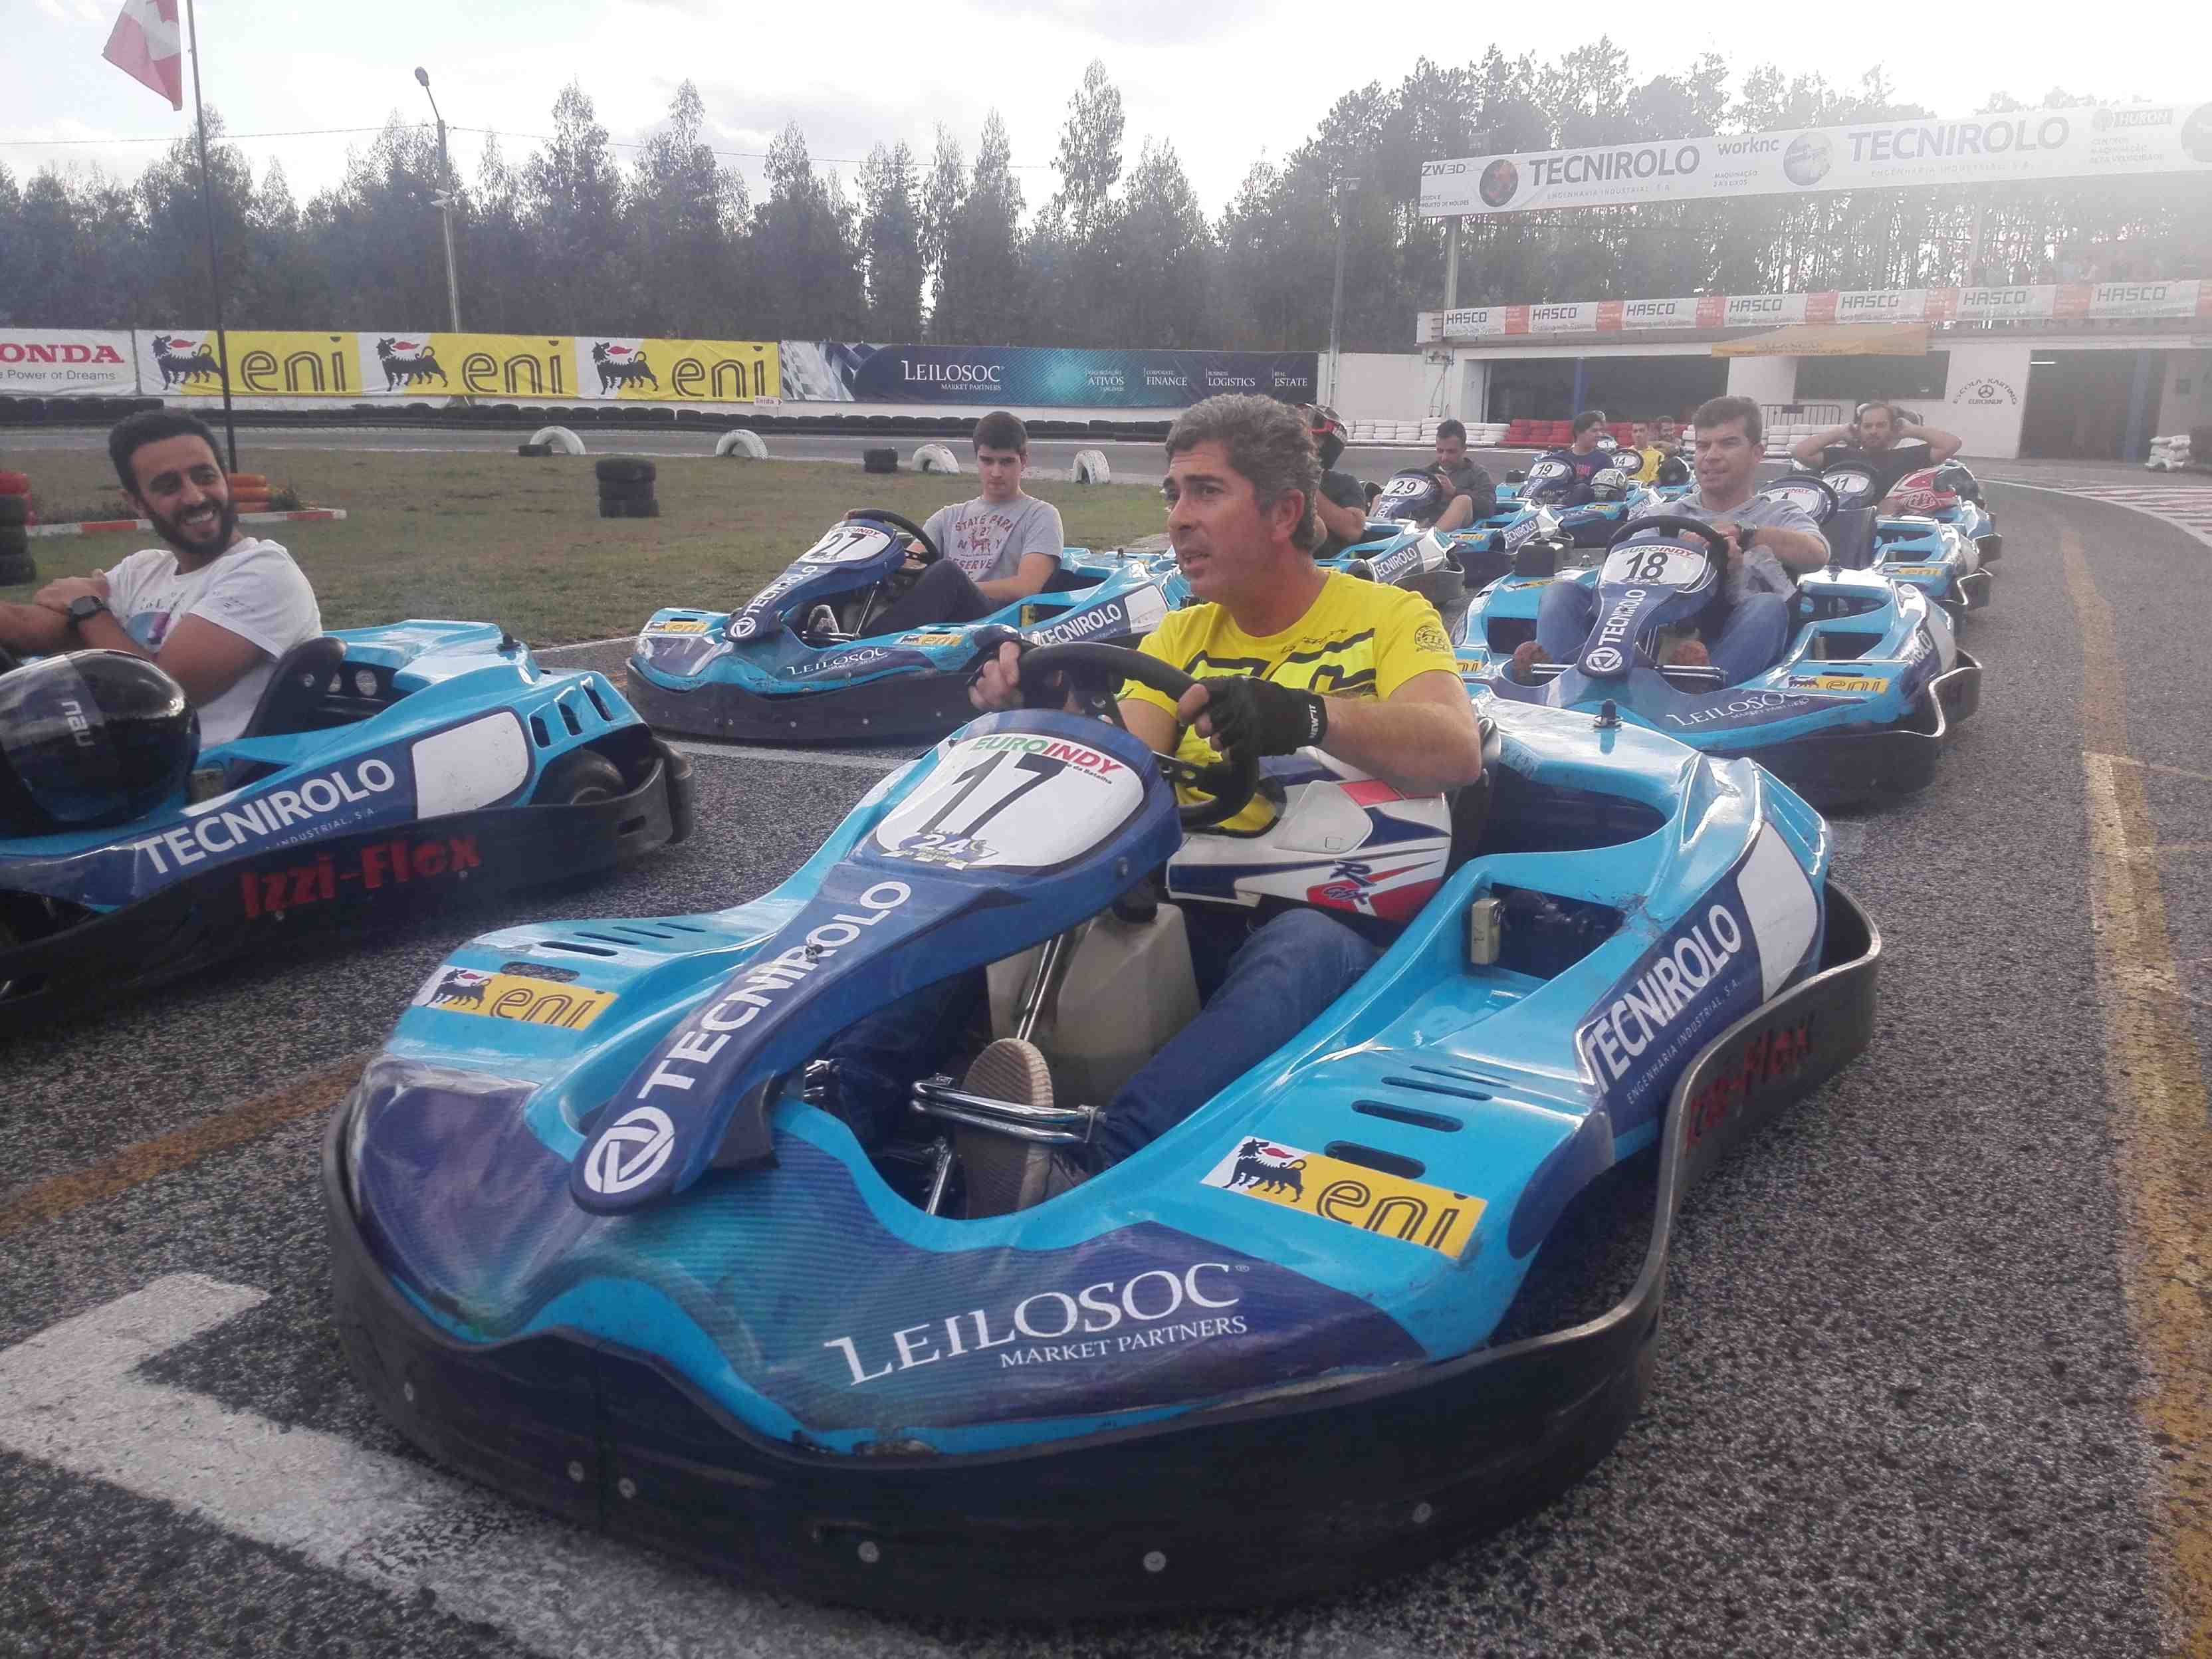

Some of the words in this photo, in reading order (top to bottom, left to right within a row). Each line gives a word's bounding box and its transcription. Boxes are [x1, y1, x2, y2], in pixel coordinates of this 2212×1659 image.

[2120, 110, 2169, 125] HURON
[1717, 136, 1779, 156] worknc
[1848, 116, 2070, 162] TECNIROLO
[1529, 146, 1700, 186] TECNIROLO
[1841, 294, 1900, 309] HASCO
[1963, 290, 2027, 305] HASCO
[2096, 286, 2167, 302] HASCO
[1532, 308, 1578, 320] HASCO
[1626, 302, 1676, 316] HASCO
[1729, 298, 1783, 313] HASCO
[1446, 311, 1487, 325] HASCO
[7, 370, 47, 380] Power
[51, 371, 62, 380] of
[66, 370, 116, 380] Dreams
[241, 336, 344, 392] eni
[462, 340, 562, 395] eni
[672, 345, 766, 398] eni
[901, 360, 1001, 382] LEILOSOC
[1087, 376, 1124, 386] ATIVOS
[1146, 376, 1187, 386] FINANCE
[1208, 377, 1256, 387] LOGISTICS
[1274, 378, 1307, 387] ESTATE
[1537, 464, 1553, 476] 19
[1390, 480, 1417, 495] 29
[1830, 477, 1849, 491] 11
[809, 532, 867, 556] 27
[1626, 552, 1669, 580] 18
[1601, 589, 1647, 645] TECNIROLO
[1826, 677, 1882, 693] eni
[972, 735, 1124, 774] EUROINDY
[917, 750, 1069, 840] 17
[134, 758, 395, 875] TECNIROLO
[910, 833, 972, 855] 24
[240, 834, 481, 919] Izzi-Flex
[637, 881, 911, 1099] TECNIROLO
[1583, 904, 1743, 1095] TECNIROLO
[490, 988, 606, 1028] eni
[1626, 1045, 1678, 1106] ENGENHARIA
[1316, 1180, 1469, 1250] eni
[824, 1263, 1240, 1386] LEILOSOC
[1000, 1340, 1111, 1369] MARKET
[1119, 1315, 1248, 1353] PARTNERS
